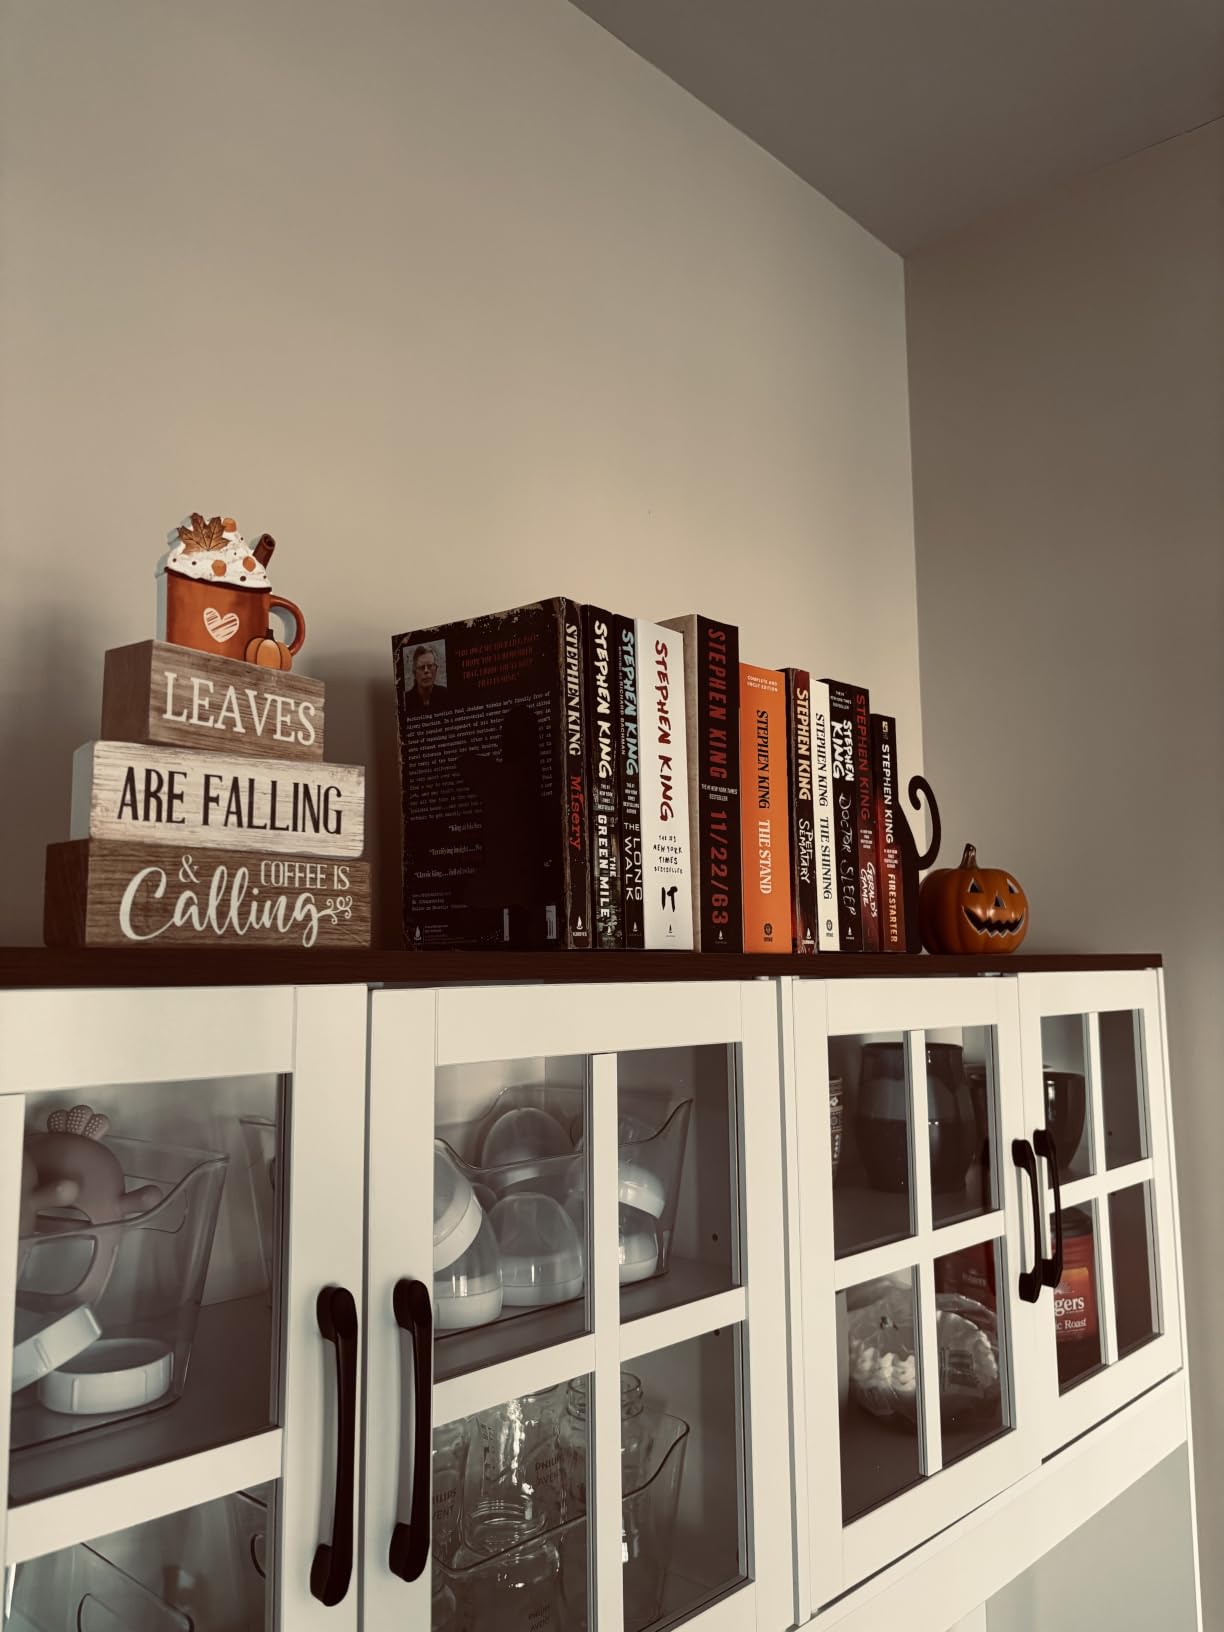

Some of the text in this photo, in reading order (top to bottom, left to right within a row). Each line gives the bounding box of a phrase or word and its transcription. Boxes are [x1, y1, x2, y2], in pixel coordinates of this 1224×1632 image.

[162, 671, 316, 746] LEAVES
[565, 623, 582, 756] STEPHEN KING
[594, 620, 613, 779] STEPHEN KING
[621, 629, 639, 776] STEPHEN KING
[708, 629, 727, 779] STEPHEN KING
[655, 640, 674, 821] STEPHEN KING
[757, 710, 770, 809] STEPHEN KING
[797, 688, 812, 801] STEPHEN KING
[816, 713, 828, 807] STEPHEN KING
[831, 721, 845, 779] KING
[843, 720, 854, 781] STEPHEN
[856, 694, 870, 772] STEPHEN
[117, 766, 344, 836] ARE FALLING
[860, 776, 870, 821] KING
[882, 744, 892, 805] STEPHEN
[569, 776, 586, 849] Misery
[623, 822, 640, 831] THE
[805, 829, 814, 859] PET
[884, 809, 894, 844] KING
[178, 854, 351, 890] & COFFEE IS
[598, 815, 610, 918] GREEN MILE
[624, 836, 634, 900] WALK
[633, 838, 643, 900] LONG
[653, 844, 682, 854] NEW YORK
[654, 866, 683, 874] BESTSELLER
[658, 856, 678, 864] TIMES
[710, 810, 728, 925] 11/22/63
[758, 819, 772, 894] THE STAND
[799, 818, 811, 884] SEMATARY
[820, 817, 832, 900] THE SHINING
[839, 792, 856, 916] DOCTOR SLEEP
[119, 864, 320, 948] Calling
[661, 886, 678, 912] IT
[861, 868, 871, 908] GAME
[866, 861, 878, 918] GERALD'S
[888, 874, 898, 943] FIRESTARTER
[1054, 1297, 1085, 1317] gers
[1064, 1318, 1087, 1329] Roast
